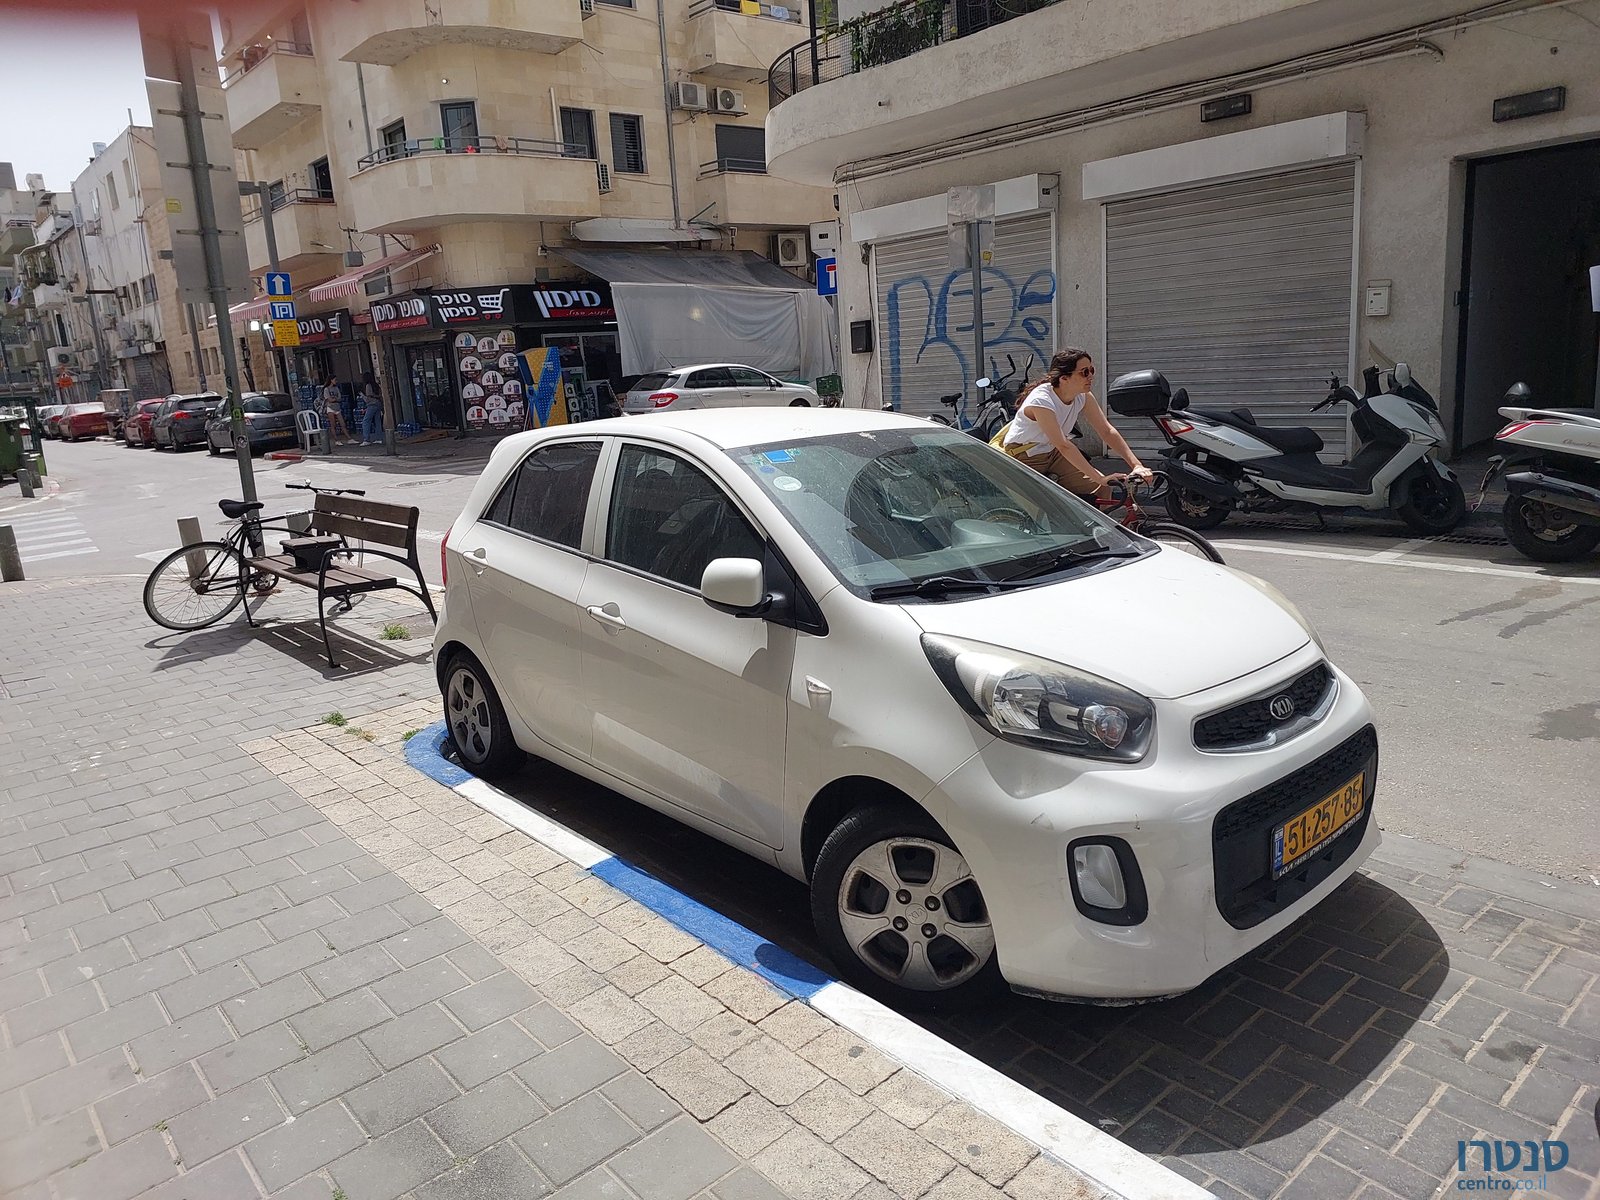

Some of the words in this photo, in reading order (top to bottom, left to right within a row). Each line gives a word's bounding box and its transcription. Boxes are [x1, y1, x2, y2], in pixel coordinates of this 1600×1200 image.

[396, 298, 425, 318] סופר
[431, 293, 472, 305] סופר
[533, 290, 601, 318] מימון
[371, 303, 395, 331] מימון
[438, 306, 477, 322] מימון
[1274, 698, 1294, 716] KIA
